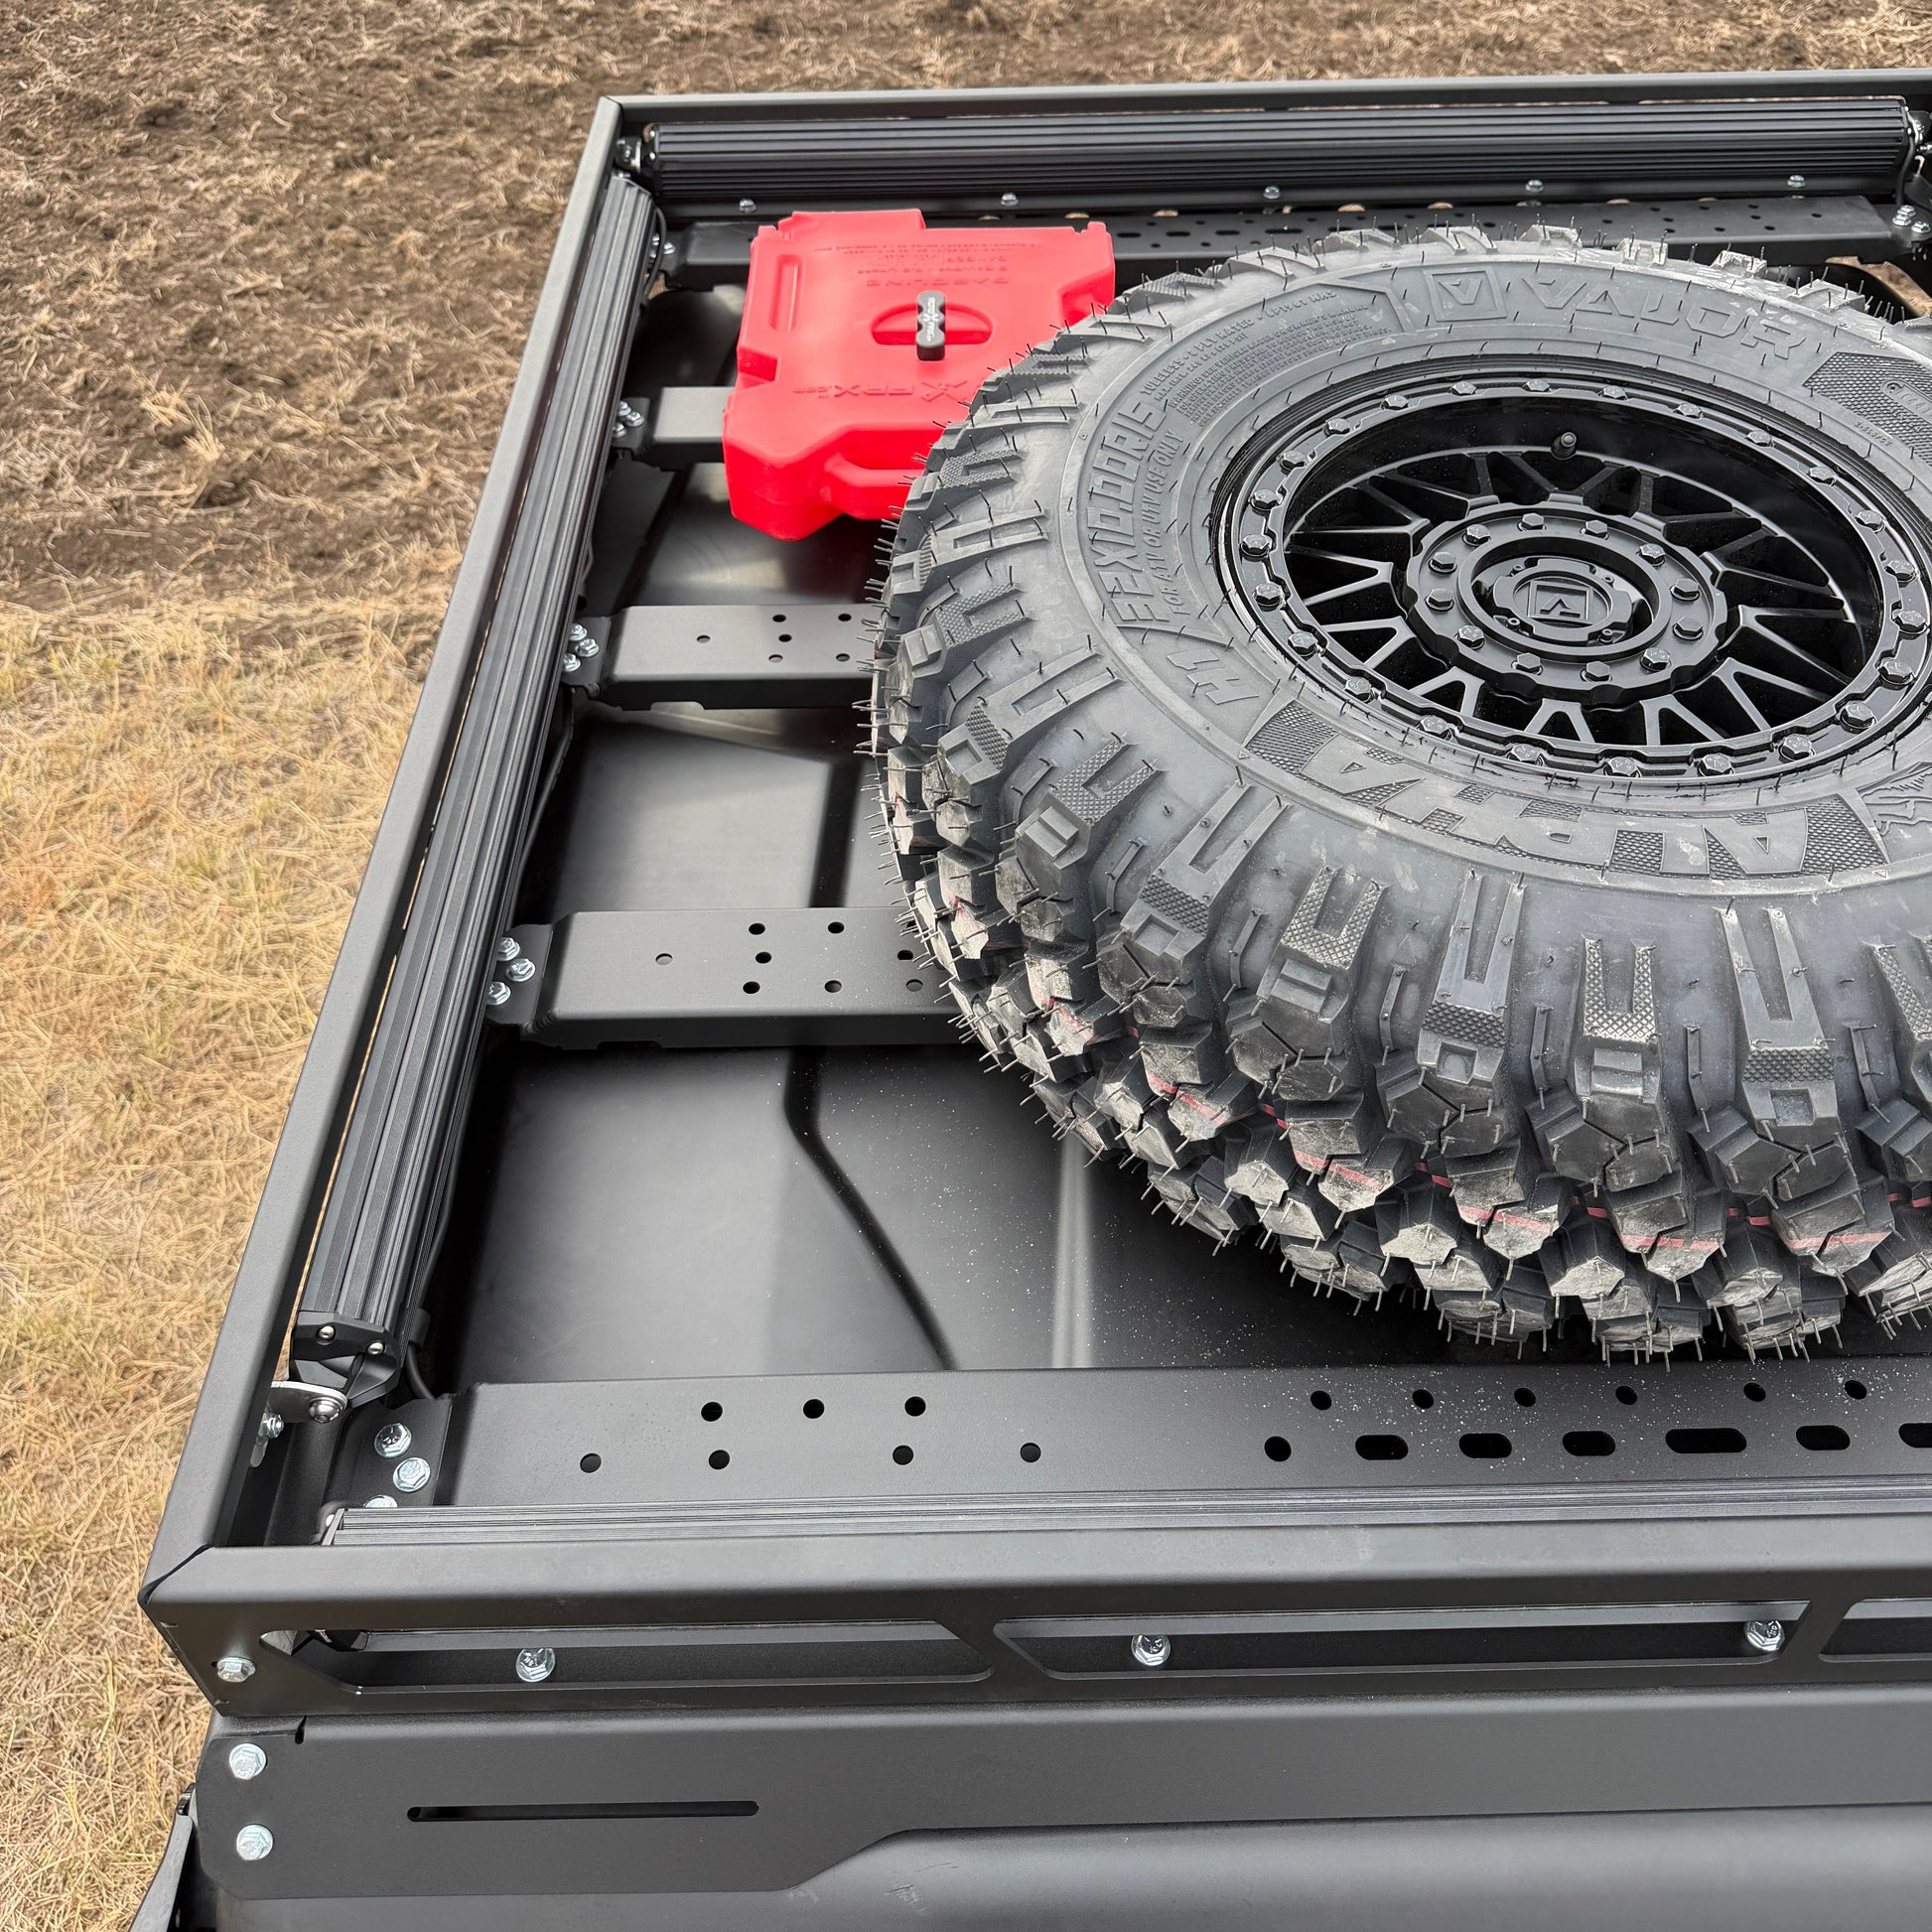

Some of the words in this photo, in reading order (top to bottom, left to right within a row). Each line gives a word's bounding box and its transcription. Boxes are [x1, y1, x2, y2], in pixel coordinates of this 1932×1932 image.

[866, 277, 1010, 287] GASOLINE
[1522, 277, 1807, 360] VALOR
[1141, 359, 1184, 396] TUBELESS
[1194, 337, 1217, 352] PLY
[1215, 318, 1255, 340] RATED
[1151, 427, 1184, 467] ONLY
[1143, 464, 1169, 494] USE
[1141, 494, 1162, 524] UTV
[1142, 526, 1163, 548] OR
[1145, 550, 1173, 583] ATV
[1159, 585, 1190, 616] FOR
[1167, 648, 1260, 706] H1
[1297, 731, 1809, 877] ALPHA
